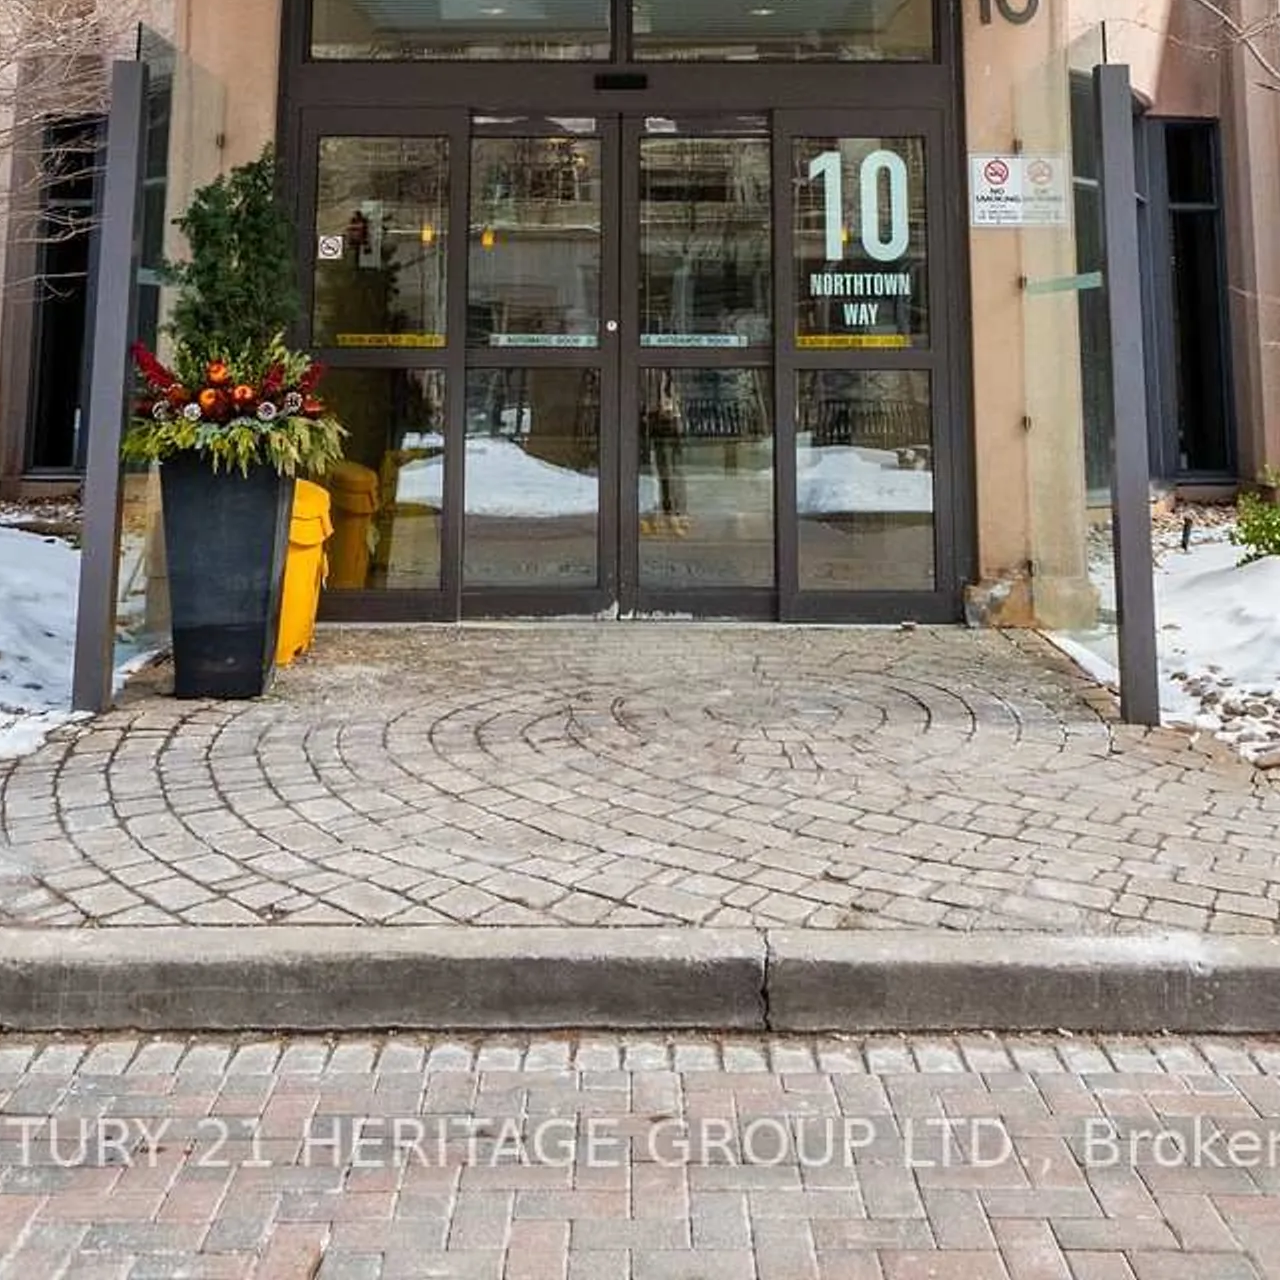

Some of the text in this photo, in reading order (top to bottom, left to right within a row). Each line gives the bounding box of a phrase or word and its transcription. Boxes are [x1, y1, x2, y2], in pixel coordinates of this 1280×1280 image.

[808, 150, 909, 261] 10
[810, 273, 911, 297] NORTHTOWN
[842, 303, 879, 326] WAY
